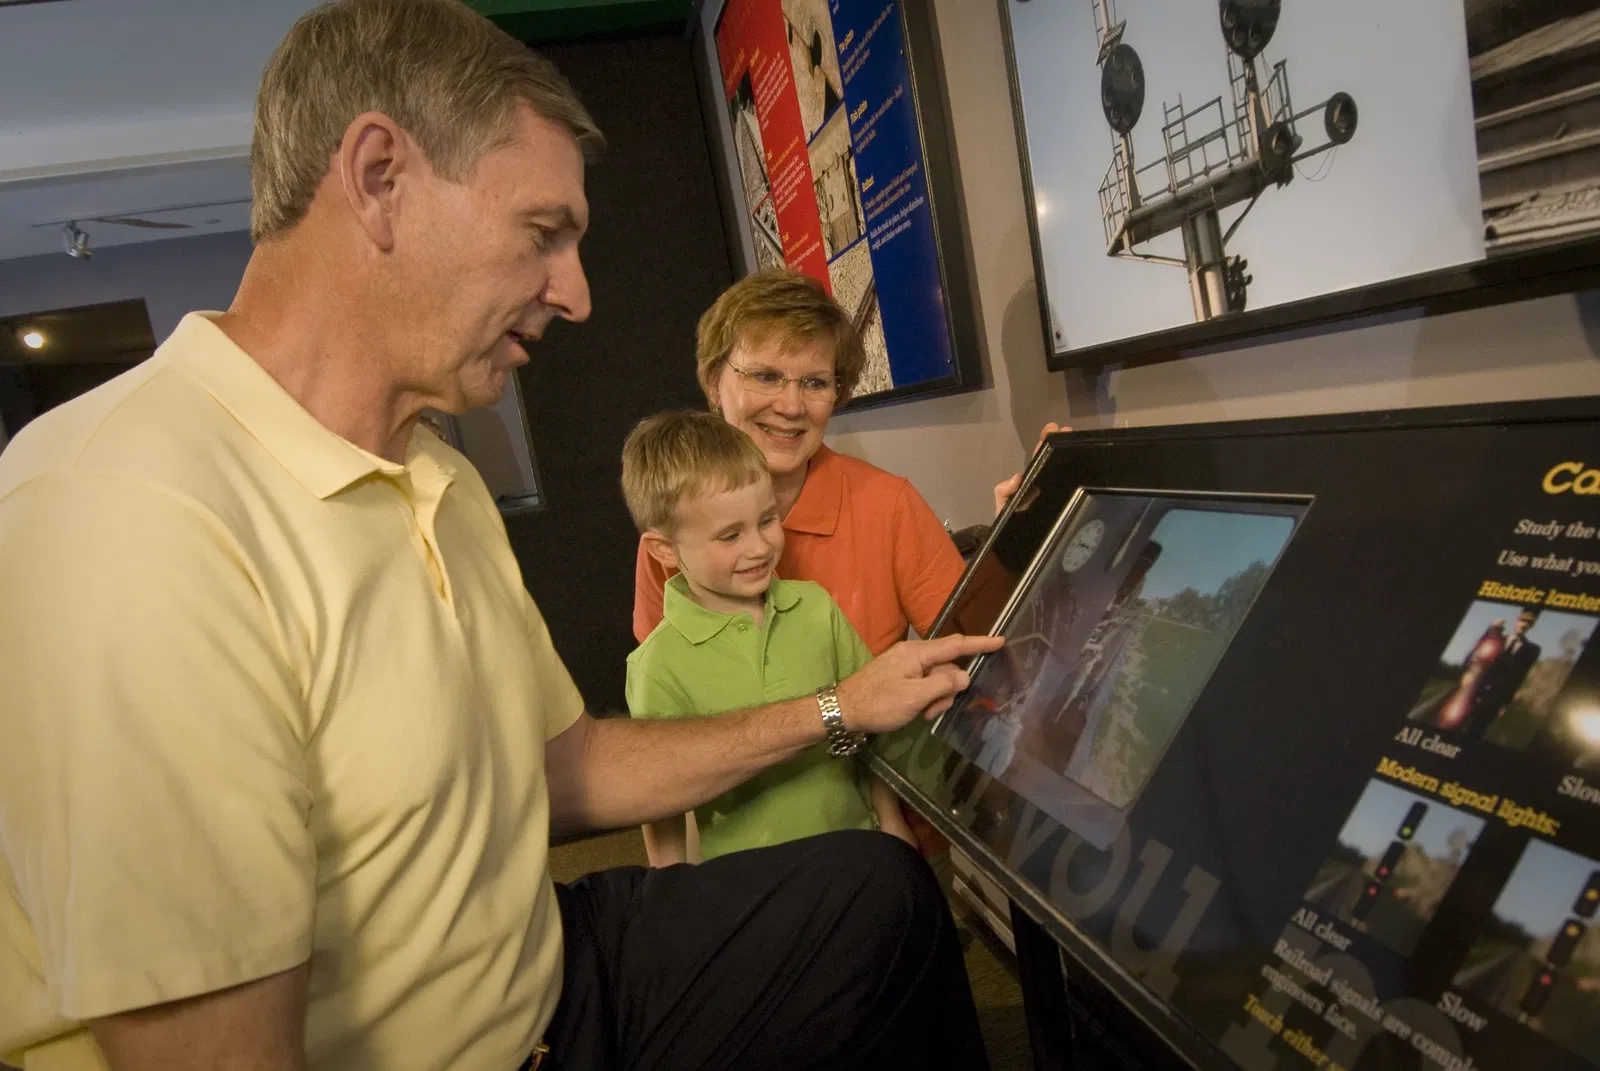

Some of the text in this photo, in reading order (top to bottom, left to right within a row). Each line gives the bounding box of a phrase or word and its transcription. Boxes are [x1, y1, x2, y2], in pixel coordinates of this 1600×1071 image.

[1514, 518, 1565, 541] Study
[1565, 520, 1596, 539] the
[1497, 549, 1529, 568] Use
[1530, 552, 1575, 573] what
[1478, 580, 1545, 604] Historic
[1394, 726, 1462, 759] All clear
[1375, 756, 1440, 793] Modern
[1439, 780, 1500, 815] signal
[1291, 907, 1353, 952] All clear
[1260, 964, 1325, 1015] engineers
[1272, 938, 1334, 986] Railroad
[1328, 979, 1384, 1021] signals
[1382, 1013, 1412, 1041] are
[1243, 993, 1330, 1067] Touch either
[1437, 991, 1488, 1033] Slow
